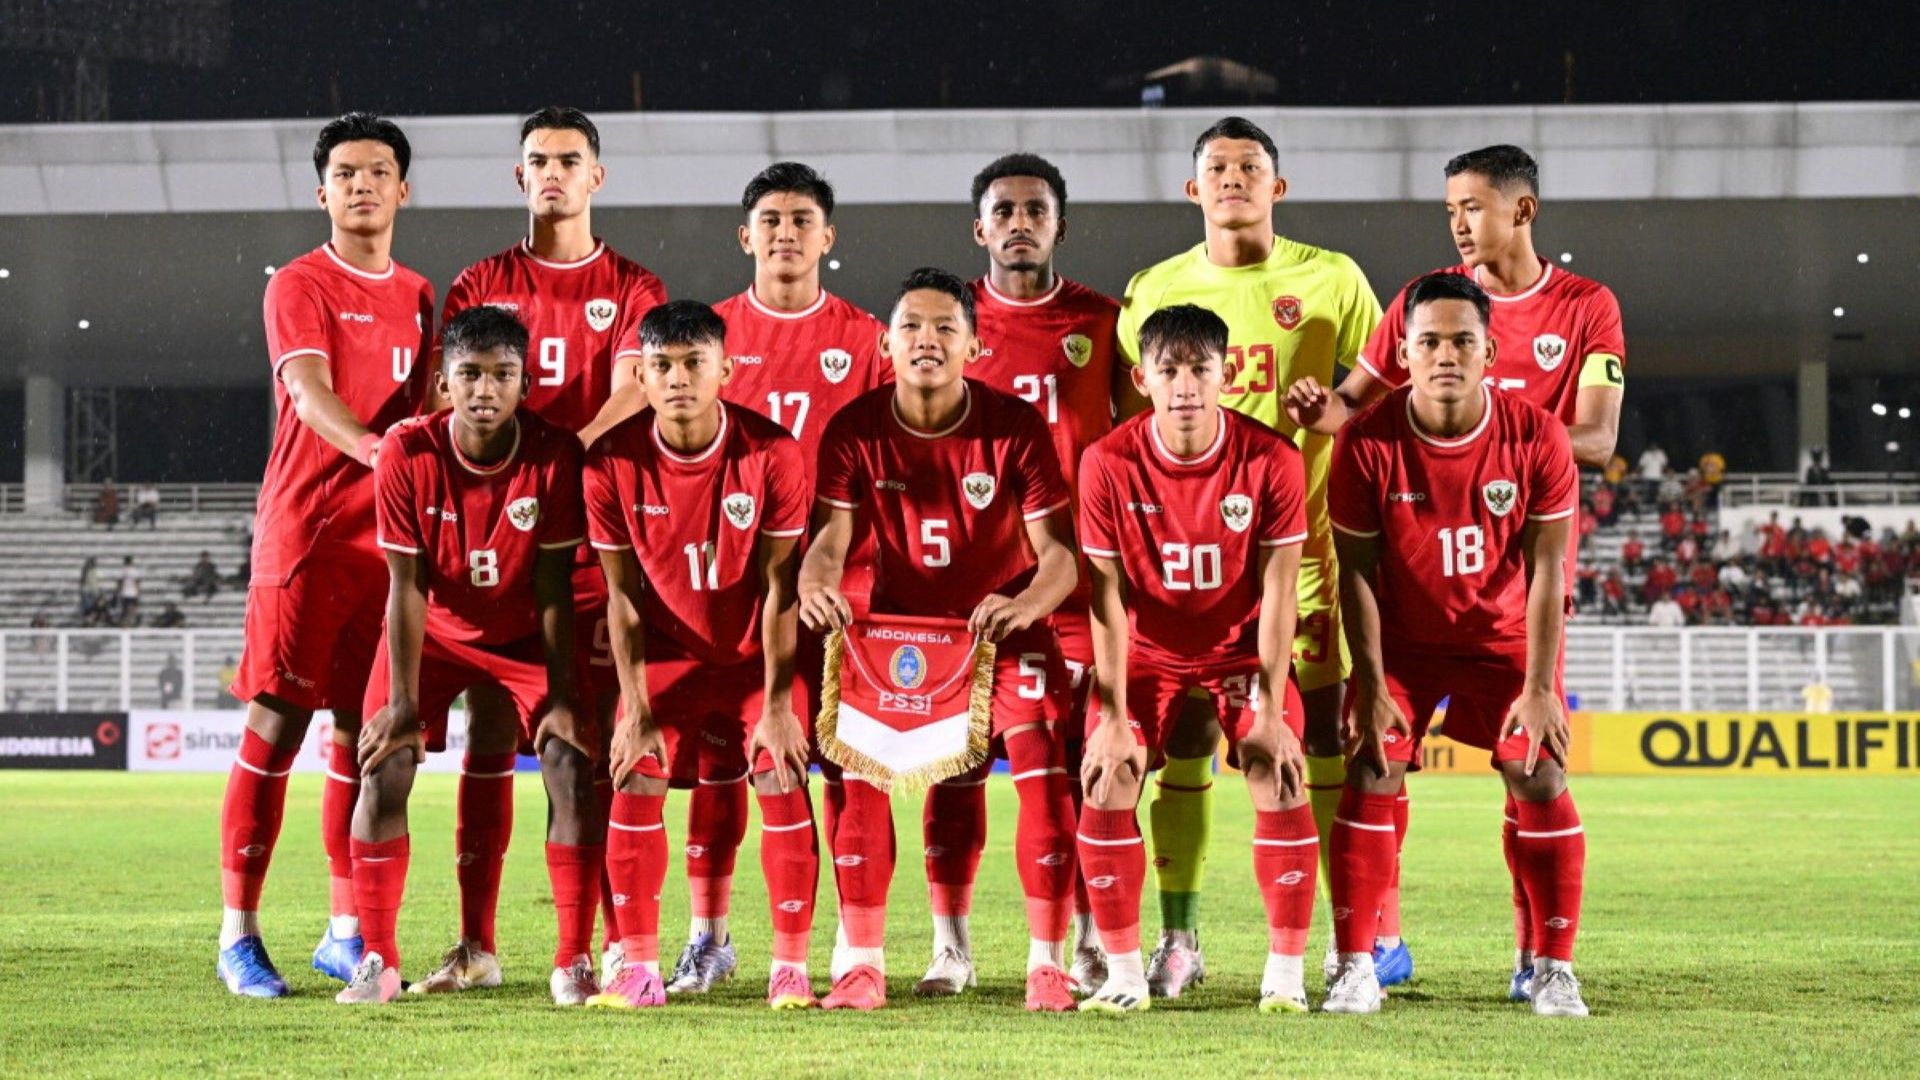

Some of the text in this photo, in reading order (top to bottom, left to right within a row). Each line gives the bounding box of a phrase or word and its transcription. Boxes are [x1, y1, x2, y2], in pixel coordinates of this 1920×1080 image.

[539, 337, 566, 386] 9
[731, 355, 762, 365] rspo
[1227, 344, 1276, 394] 23
[767, 391, 810, 441] 17
[1013, 374, 1057, 423] 21
[683, 541, 719, 590] 11
[921, 519, 951, 567] 5
[1162, 542, 1222, 591] 20
[1437, 525, 1485, 577] 18
[469, 549, 499, 587] 8
[866, 627, 953, 645] INDONESIA
[1018, 652, 1046, 700] 5
[1641, 719, 1920, 768] QUALIFI
